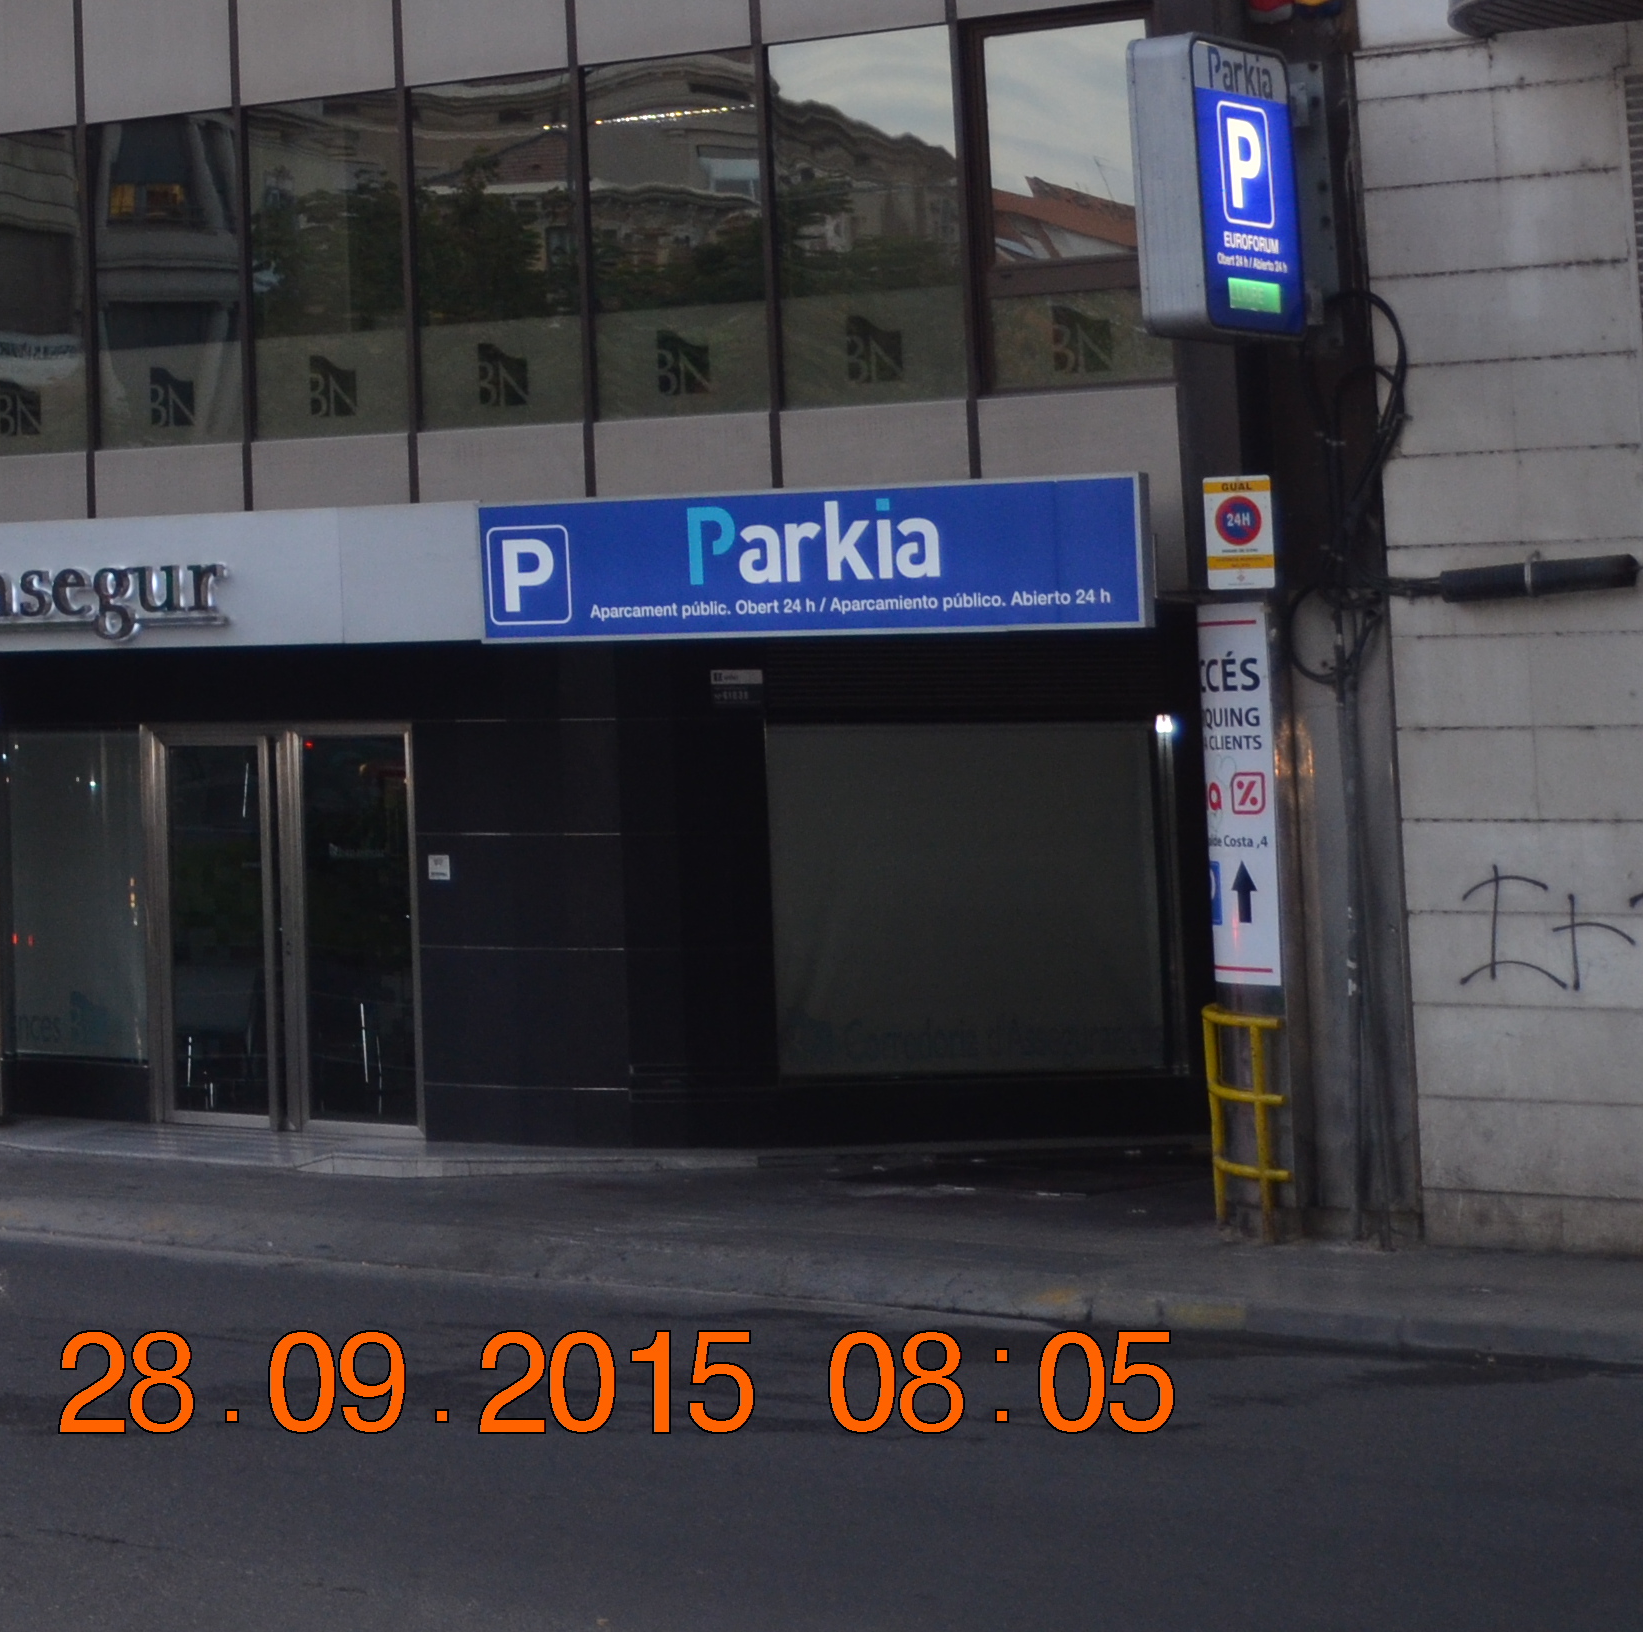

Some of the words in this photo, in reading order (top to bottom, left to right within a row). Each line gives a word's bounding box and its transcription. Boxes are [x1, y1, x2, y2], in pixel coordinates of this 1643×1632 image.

[1207, 46, 1273, 100] Parkia
[1227, 117, 1261, 209] P
[1223, 231, 1280, 255] EUROFORUM
[1221, 482, 1252, 492] GUAL
[1226, 512, 1251, 527] 24H
[687, 498, 941, 586] Parkia
[502, 539, 554, 612] P
[590, 602, 678, 621] Aparcament
[682, 600, 731, 619] públic.
[735, 599, 779, 615] Obert
[783, 598, 802, 613] 24
[806, 597, 816, 613] h
[820, 597, 827, 612] /
[830, 594, 938, 614] Aparcamiento
[942, 592, 1007, 612] público.
[1010, 590, 1071, 606] Abierto
[1075, 589, 1096, 604] 24
[1100, 588, 1111, 604] h
[1209, 734, 1262, 750] CLIENTS
[1224, 835, 1253, 847] Costa
